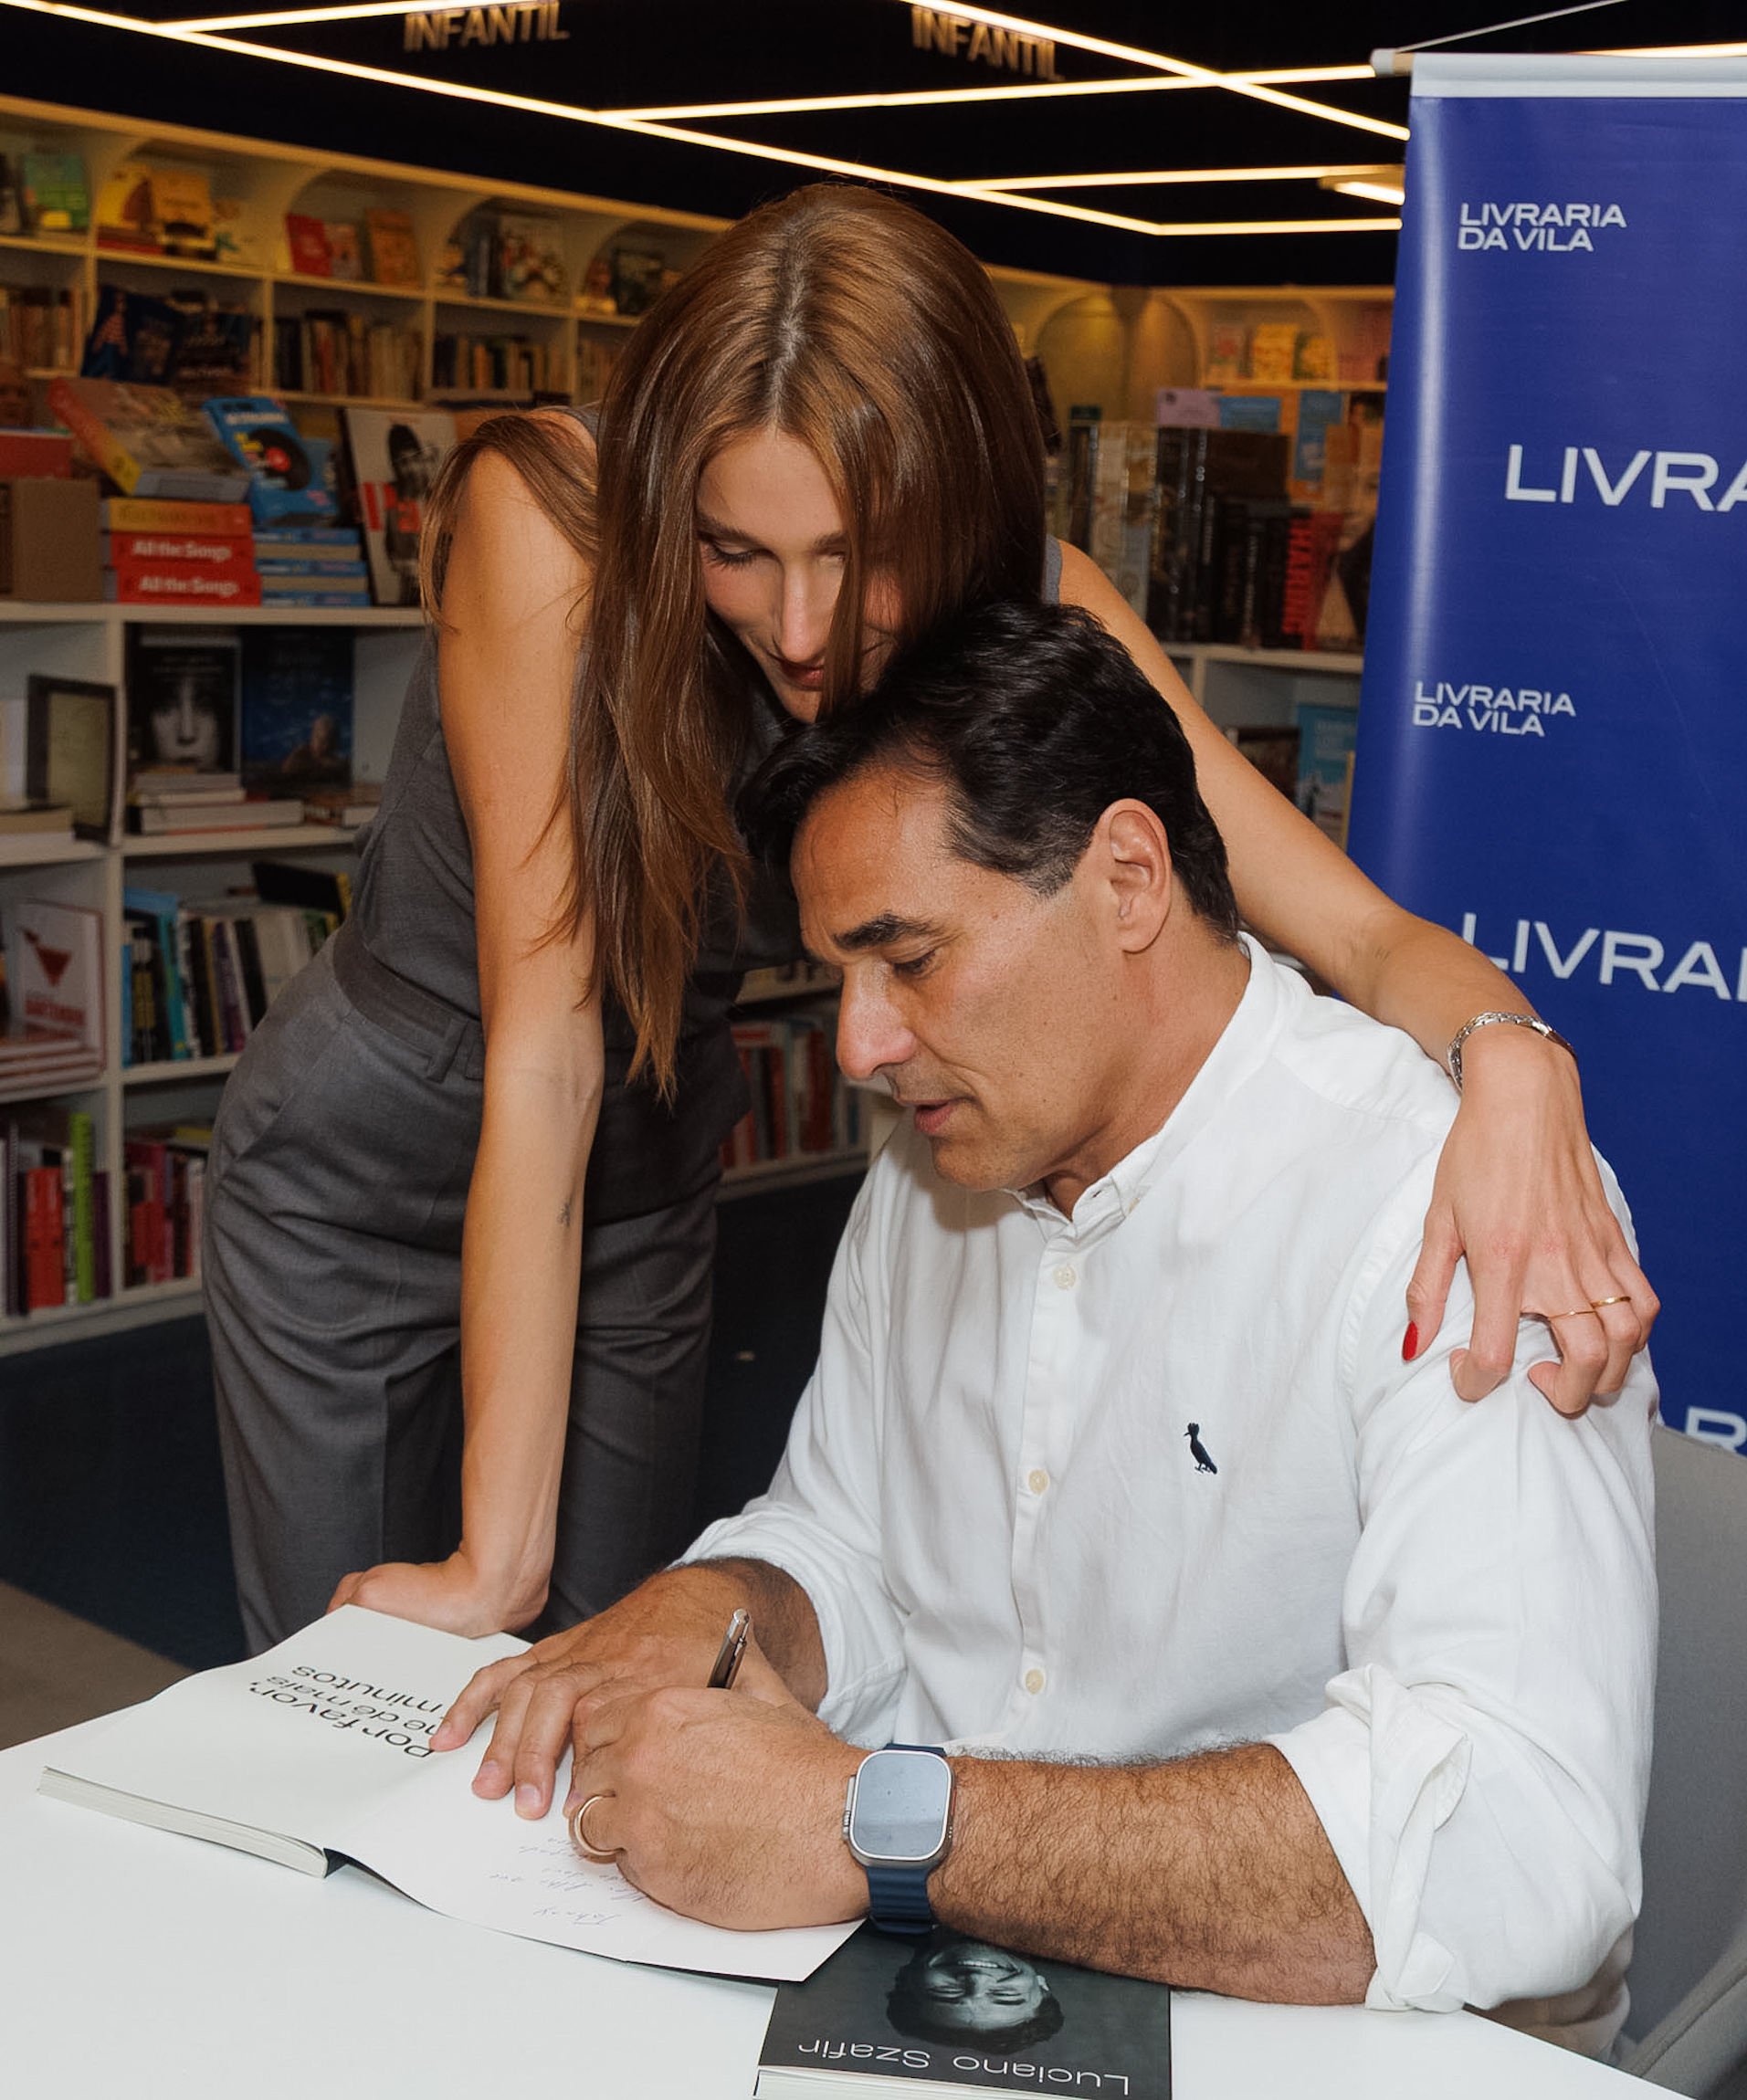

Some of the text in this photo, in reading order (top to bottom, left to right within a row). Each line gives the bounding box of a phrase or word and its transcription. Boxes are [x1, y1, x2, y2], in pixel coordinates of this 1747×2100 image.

[404, 3, 570, 51] INFANTIL
[911, 5, 1066, 81] INFANTIL
[1461, 203, 1627, 227] LIVRARIA
[1458, 227, 1594, 252] DA VILA
[1413, 703, 1545, 737] DA VILA
[1415, 681, 1576, 717] LIVRARIA
[267, 1676, 353, 1706] mais
[291, 1665, 443, 1713] minutos
[249, 1682, 435, 1758] Por favor,
[798, 2039, 1130, 2096] Luciano Szafir
